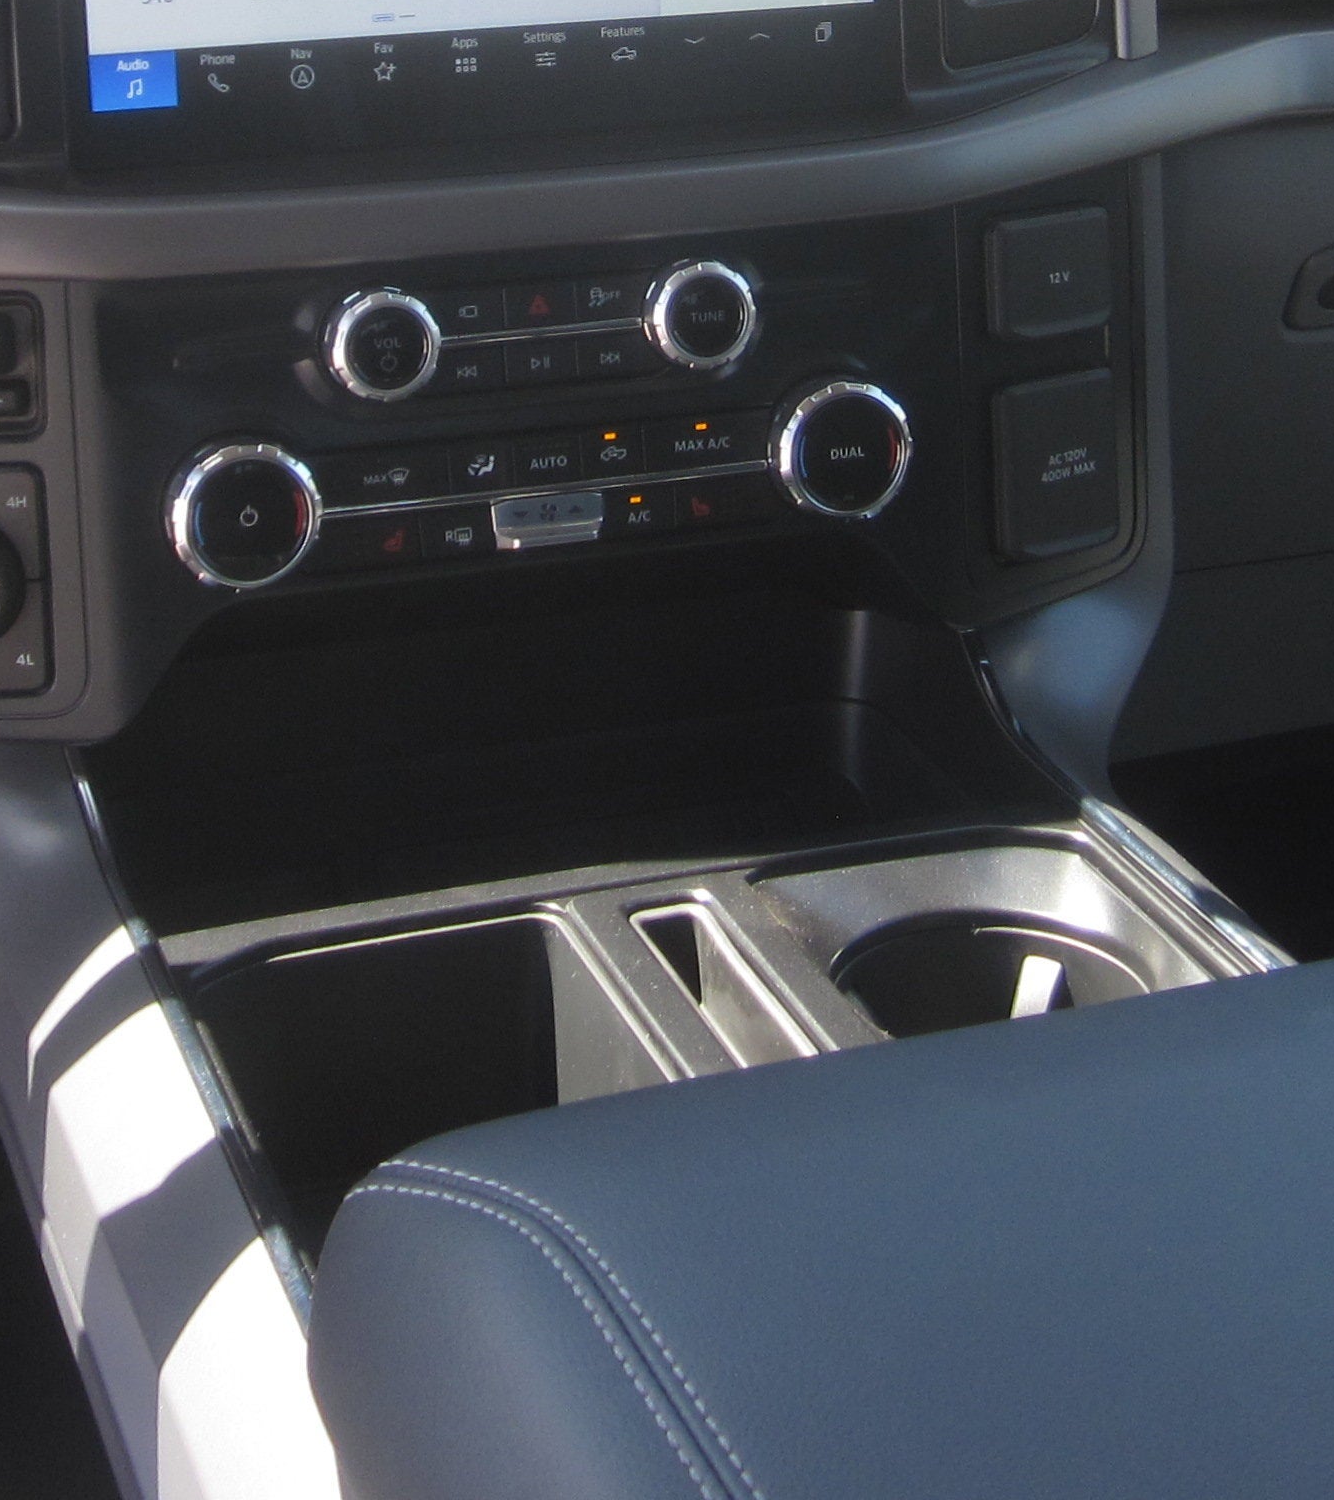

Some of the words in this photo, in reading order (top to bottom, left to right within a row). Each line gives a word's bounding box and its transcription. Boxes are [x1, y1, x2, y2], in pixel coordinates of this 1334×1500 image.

[523, 30, 566, 45] Settings
[601, 25, 645, 38] Features
[374, 42, 394, 54] Fav
[451, 36, 478, 50] Apps
[200, 53, 236, 66] Phone
[291, 48, 312, 60] Nav
[117, 59, 149, 72] Audio
[1049, 271, 1060, 284] 12
[1061, 270, 1071, 283] V
[690, 309, 725, 323] TUNE
[373, 337, 402, 350] VOL
[675, 438, 704, 452] MAX
[707, 436, 731, 450] A/C
[830, 446, 865, 461] DUAL
[530, 455, 567, 471] AUTO
[5, 496, 28, 508] 4H
[628, 510, 651, 524] A/C
[16, 653, 34, 666] 4L
